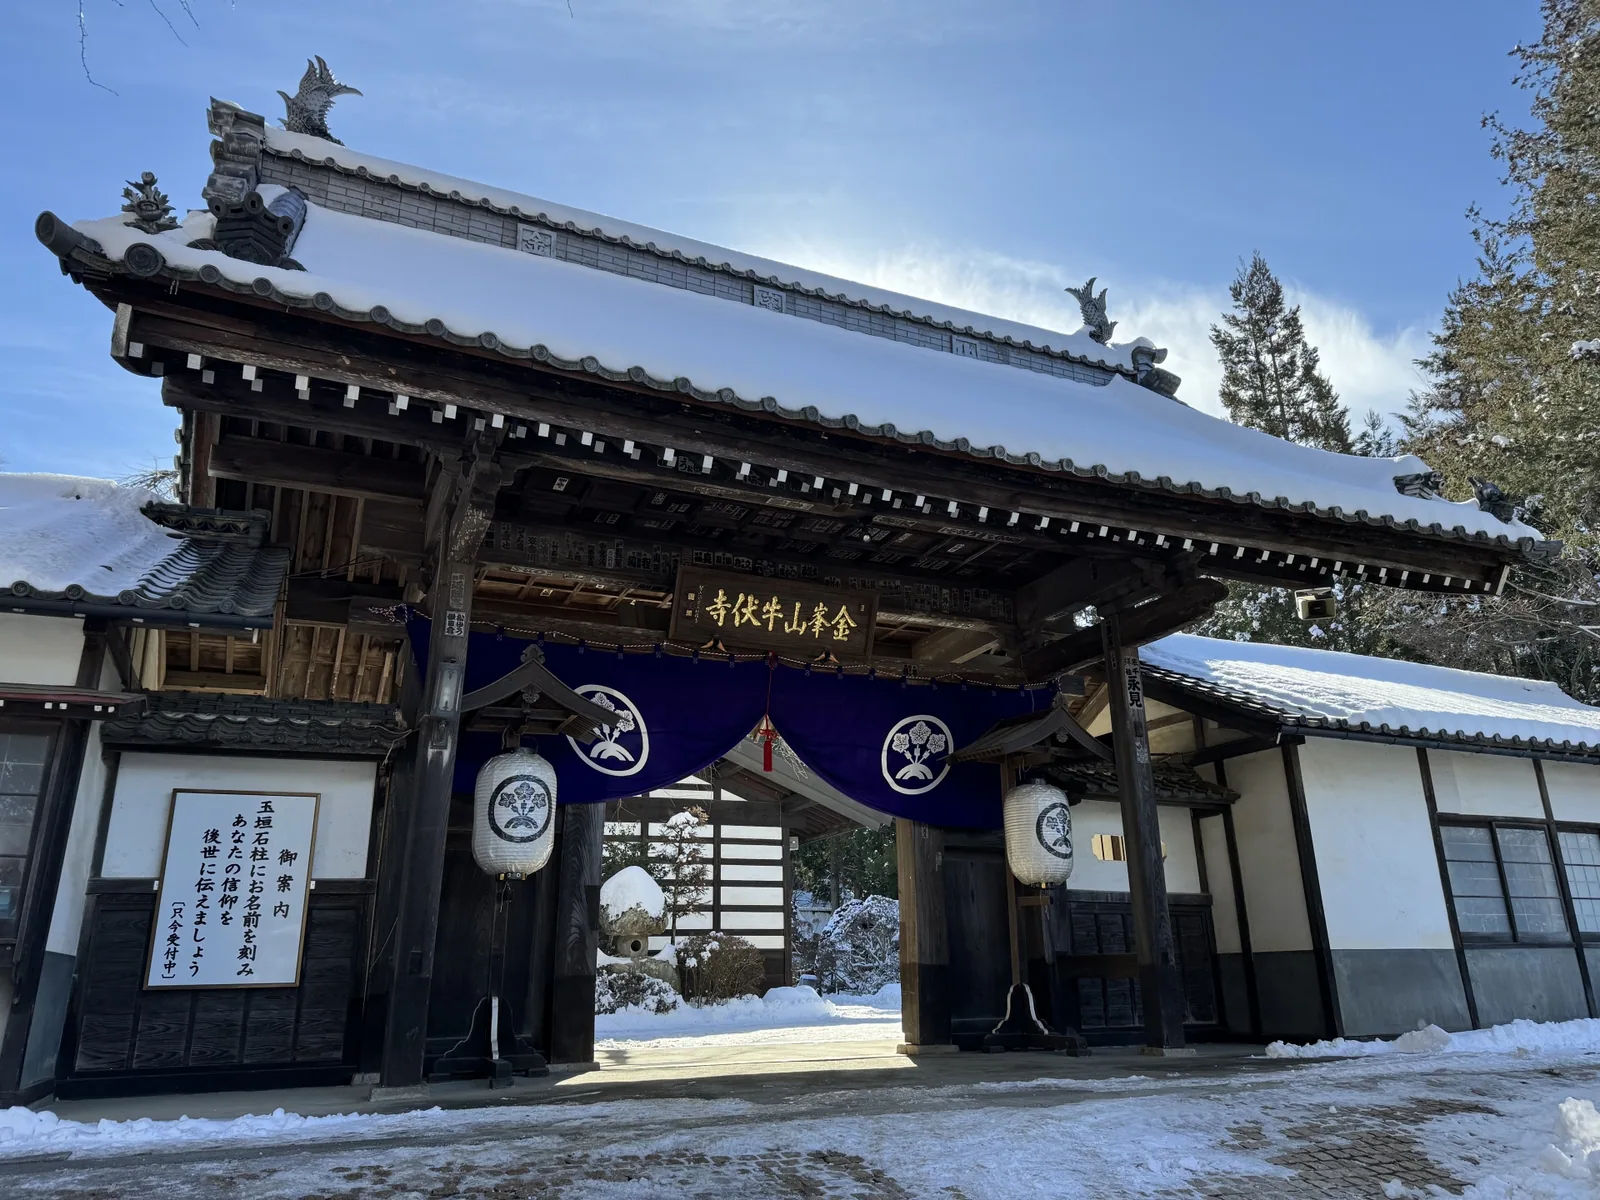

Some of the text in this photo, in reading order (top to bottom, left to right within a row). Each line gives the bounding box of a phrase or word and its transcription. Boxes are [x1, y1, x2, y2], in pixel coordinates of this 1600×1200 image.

[189, 828, 222, 978] 後世に伝えましょう
[218, 813, 247, 926] あなたの信仰を
[236, 800, 275, 977] 玉垣石柱にお名前を刻み
[273, 848, 298, 919] 御案内
